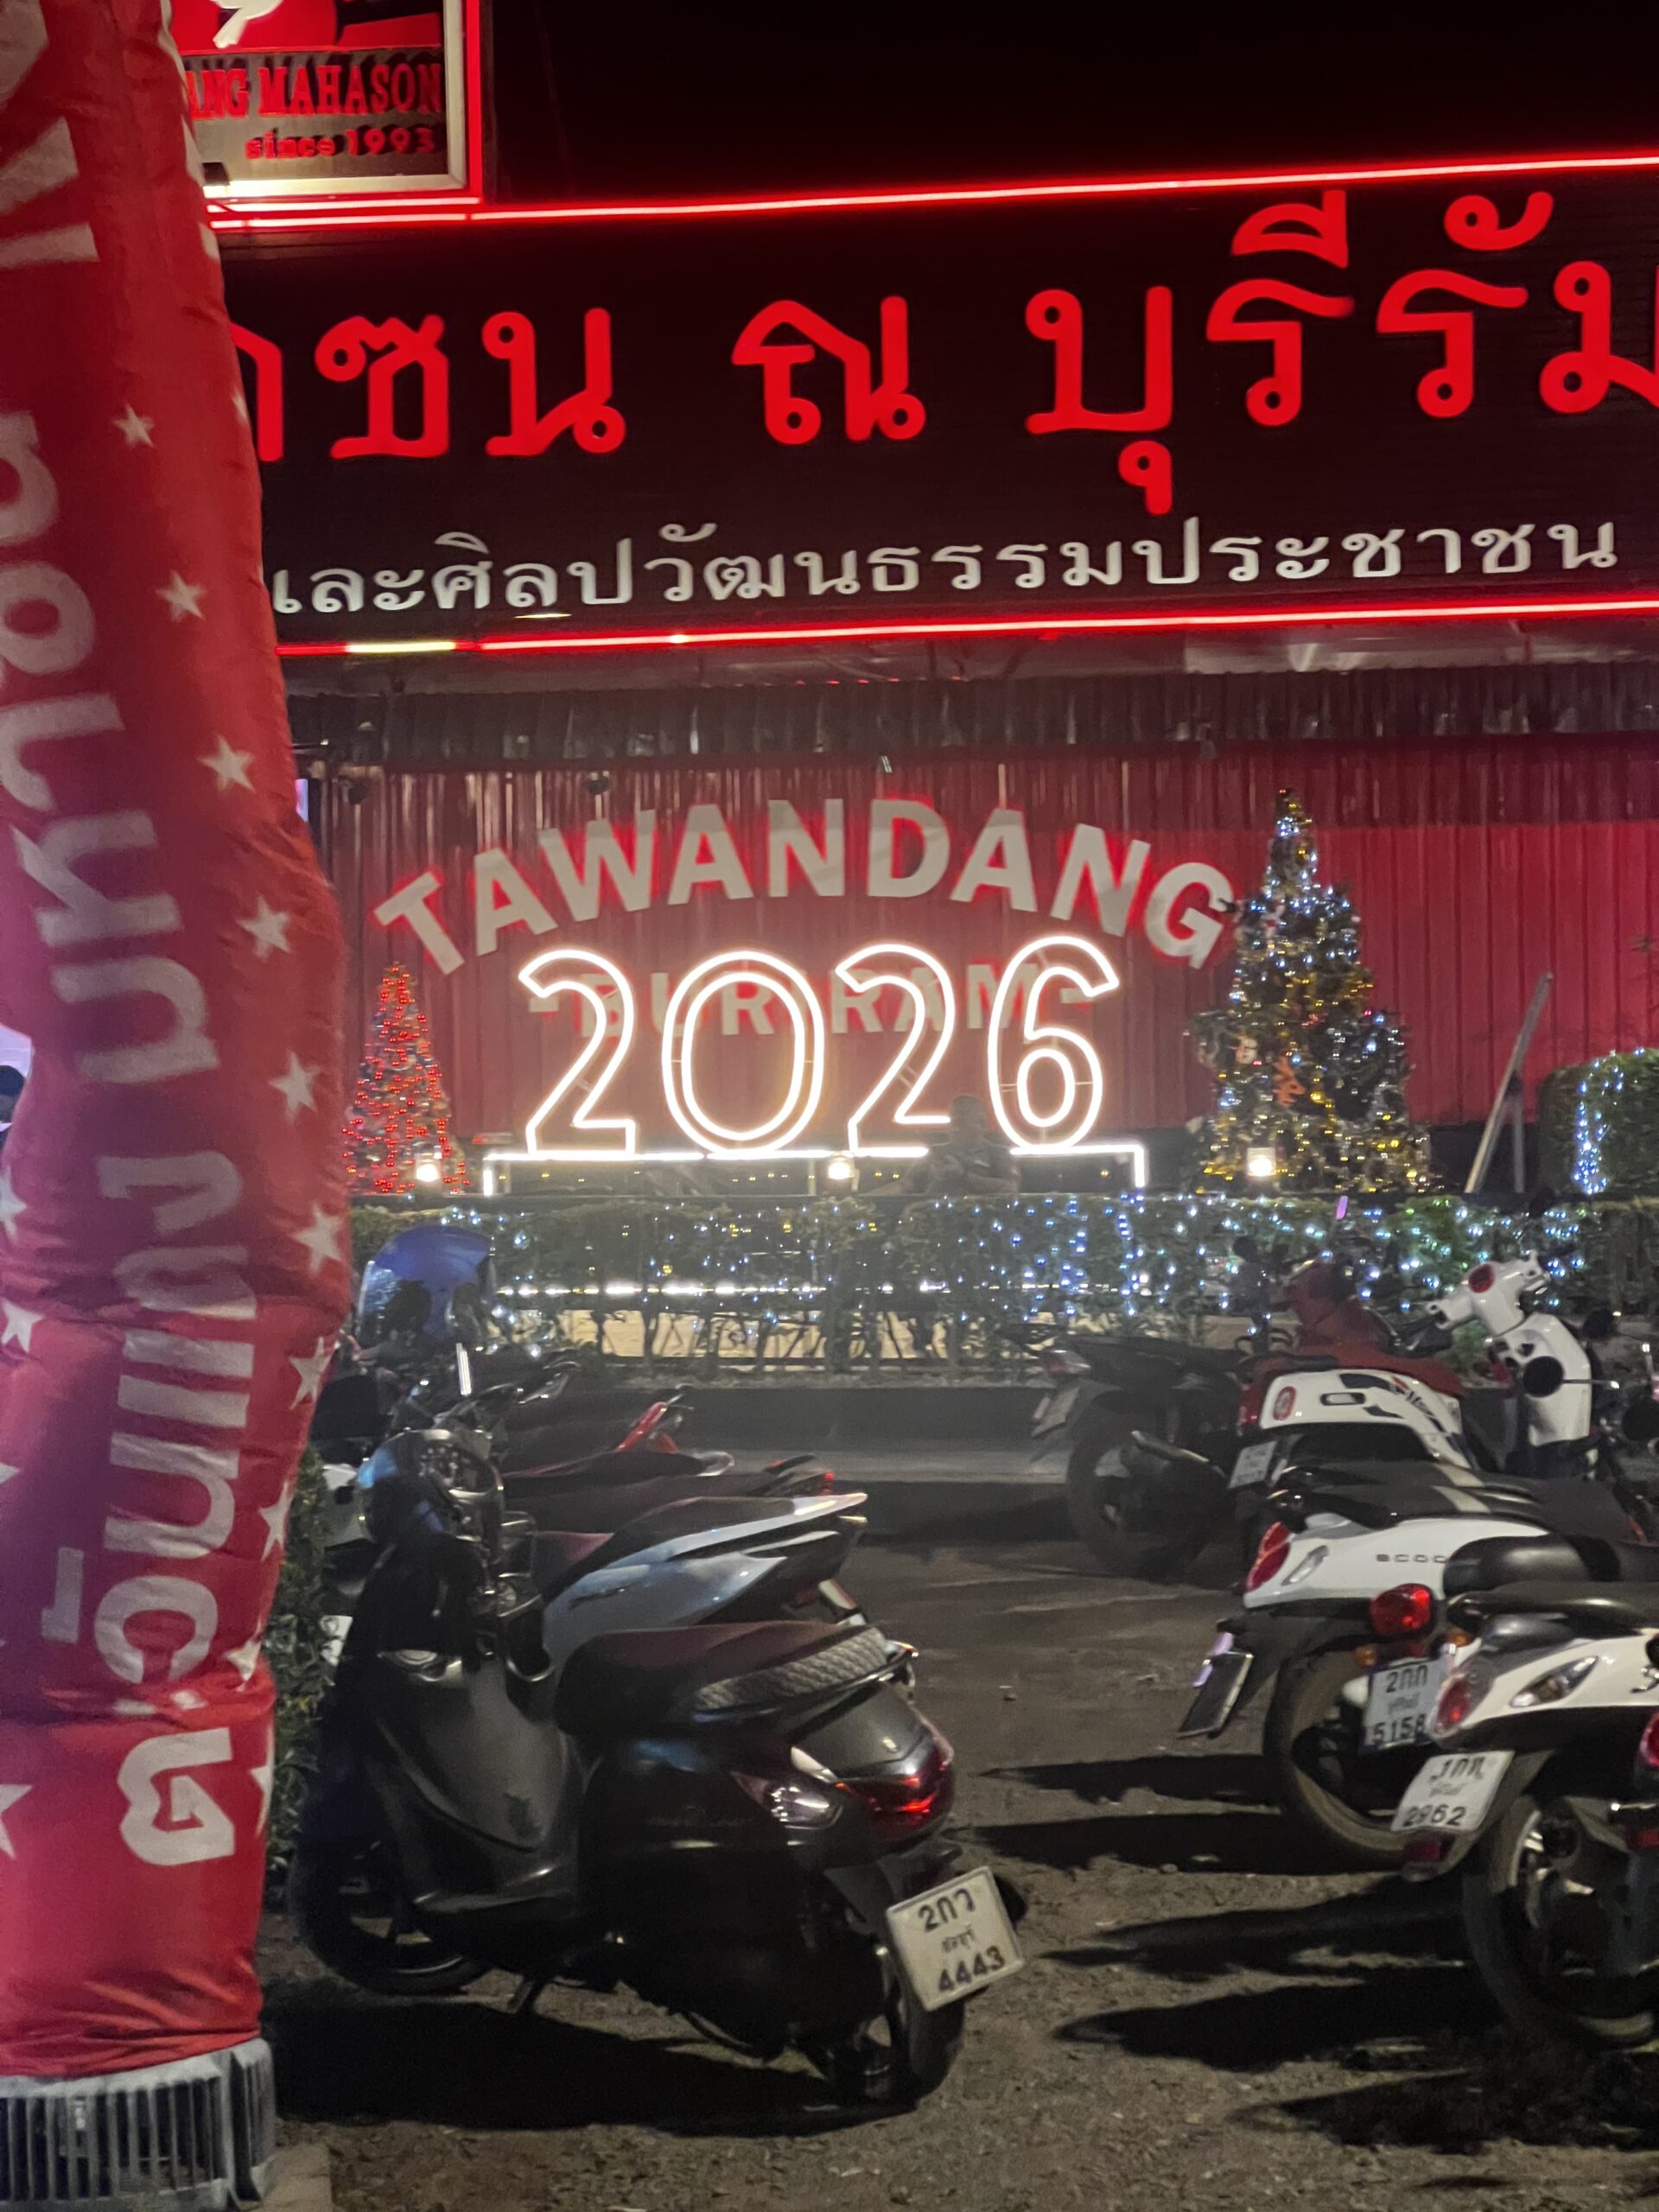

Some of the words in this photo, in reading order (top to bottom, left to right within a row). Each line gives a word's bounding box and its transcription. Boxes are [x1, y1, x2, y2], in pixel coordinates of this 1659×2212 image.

[245, 130, 336, 160] since
[346, 127, 435, 156] 1993
[257, 63, 442, 118] MAHASON
[732, 295, 927, 446] ณ
[372, 799, 1234, 974] TAWANDANG
[518, 936, 1121, 1160] 2026
[41, 1151, 256, 1866] ตวันแดง
[938, 1945, 1006, 1993] 4443
